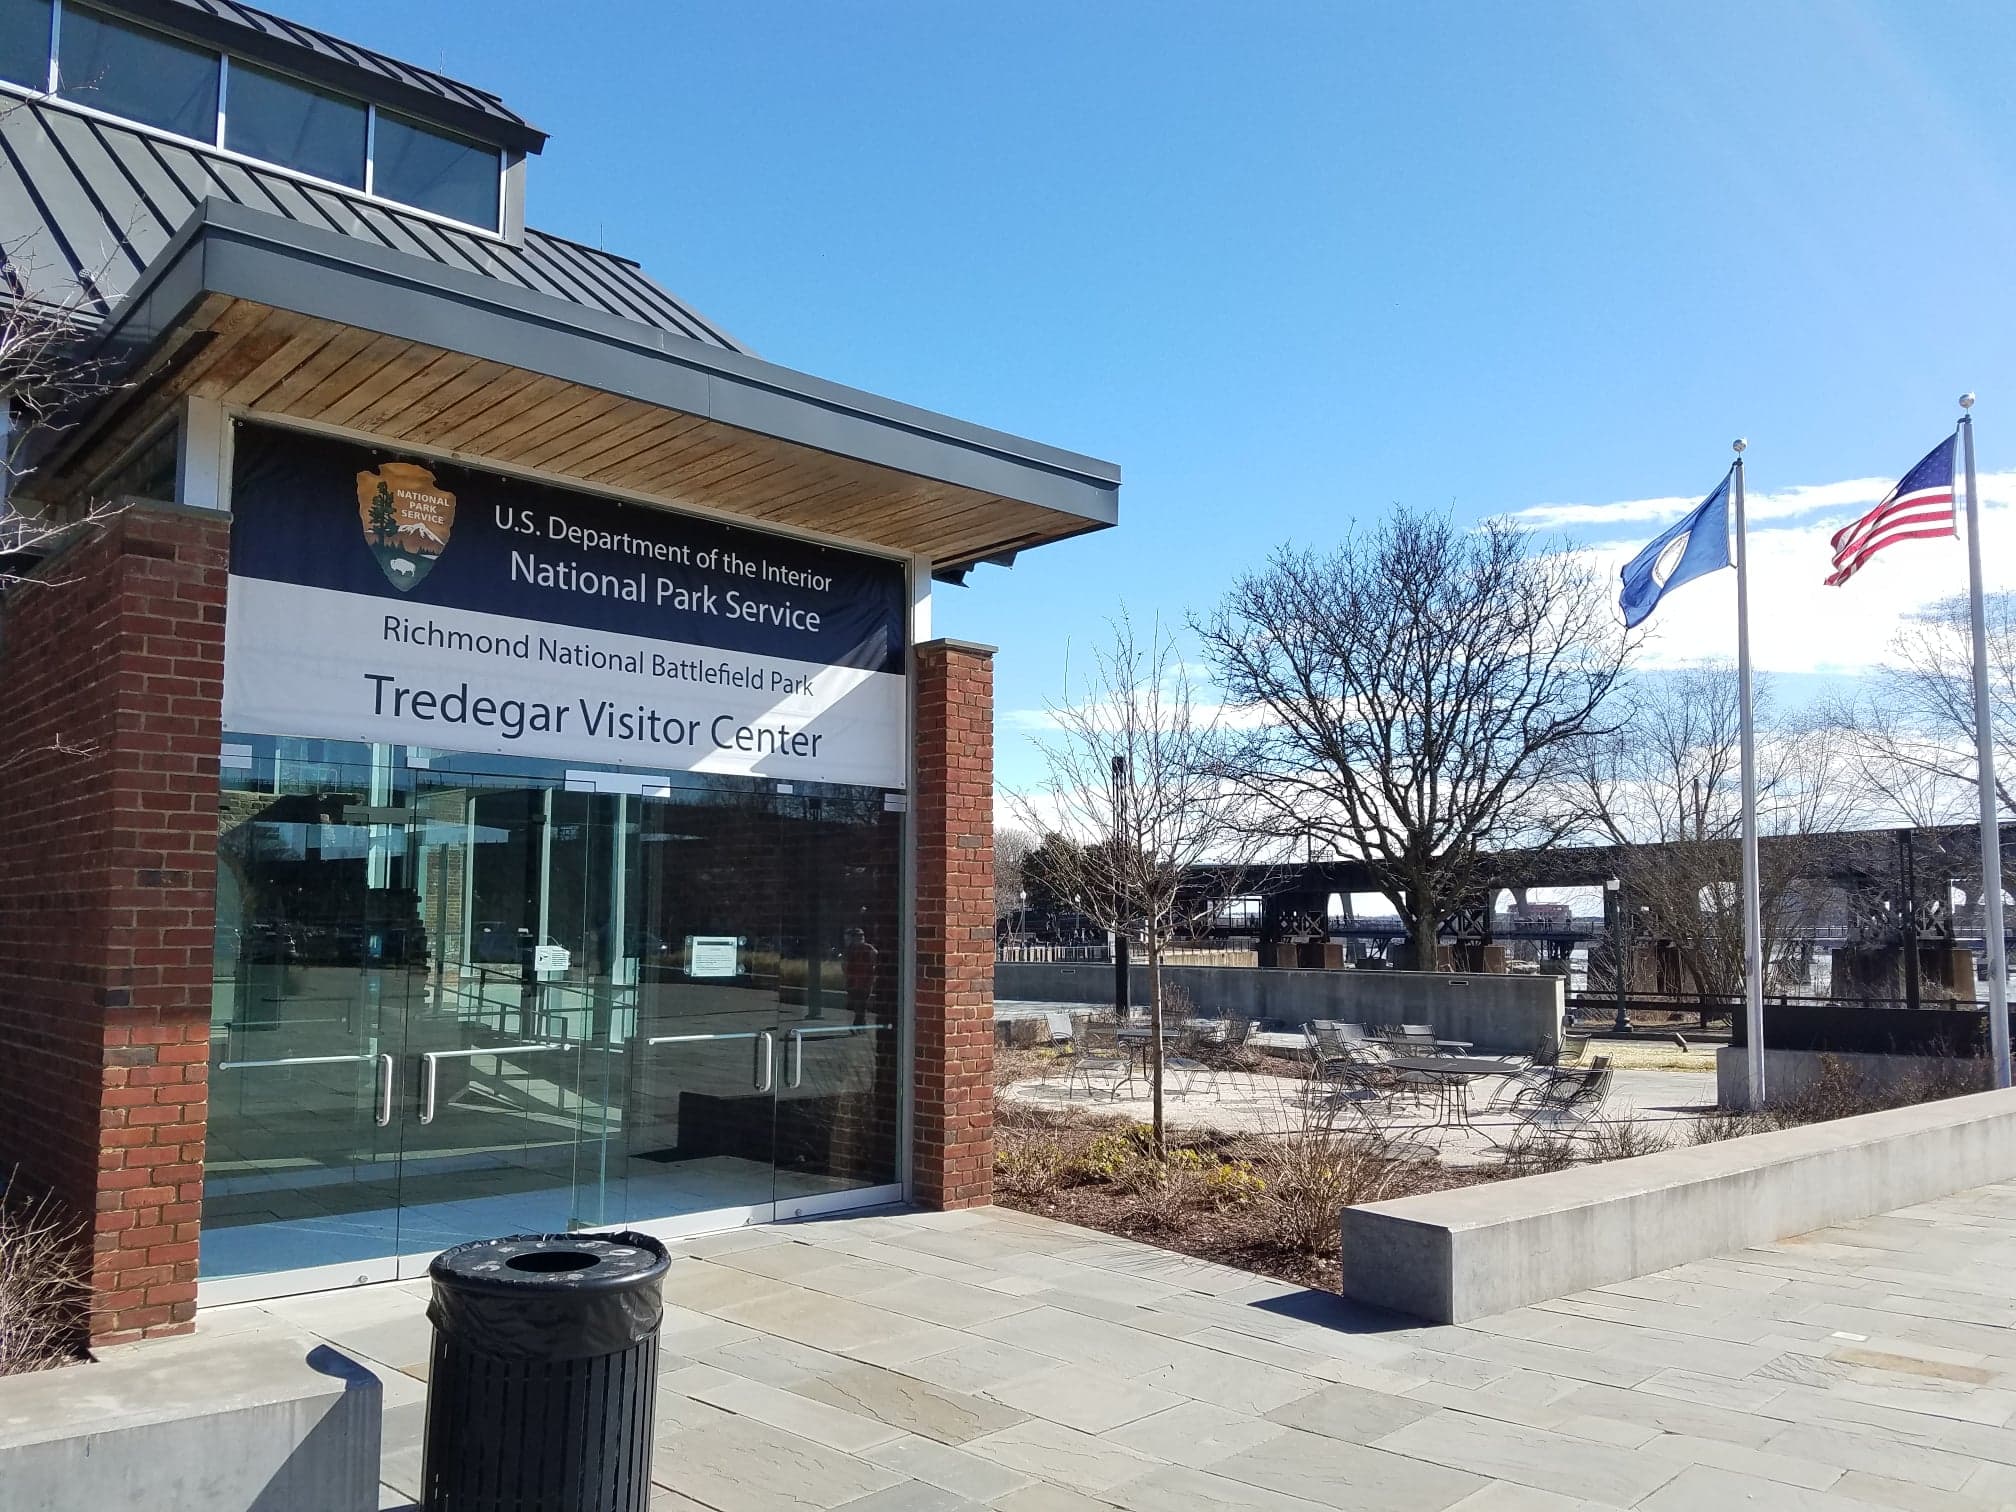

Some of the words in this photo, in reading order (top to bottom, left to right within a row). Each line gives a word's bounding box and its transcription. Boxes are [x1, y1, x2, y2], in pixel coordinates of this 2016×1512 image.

[397, 489, 450, 507] NATIONAL
[401, 509, 444, 525] SERVICE
[409, 501, 437, 514] PARK
[495, 504, 541, 536] U.S.
[549, 515, 691, 566] Department
[696, 549, 719, 570] of
[723, 552, 757, 578] the
[762, 560, 832, 592] Interior
[511, 550, 646, 603] National
[657, 577, 719, 616] Park
[725, 591, 821, 632] Service
[383, 615, 529, 659] Richmond
[539, 637, 644, 675] National
[652, 654, 764, 691] Battlefield
[771, 671, 814, 697] Park
[364, 673, 570, 739] Tredegar
[579, 698, 700, 746] Visitor
[711, 714, 823, 758] Center
